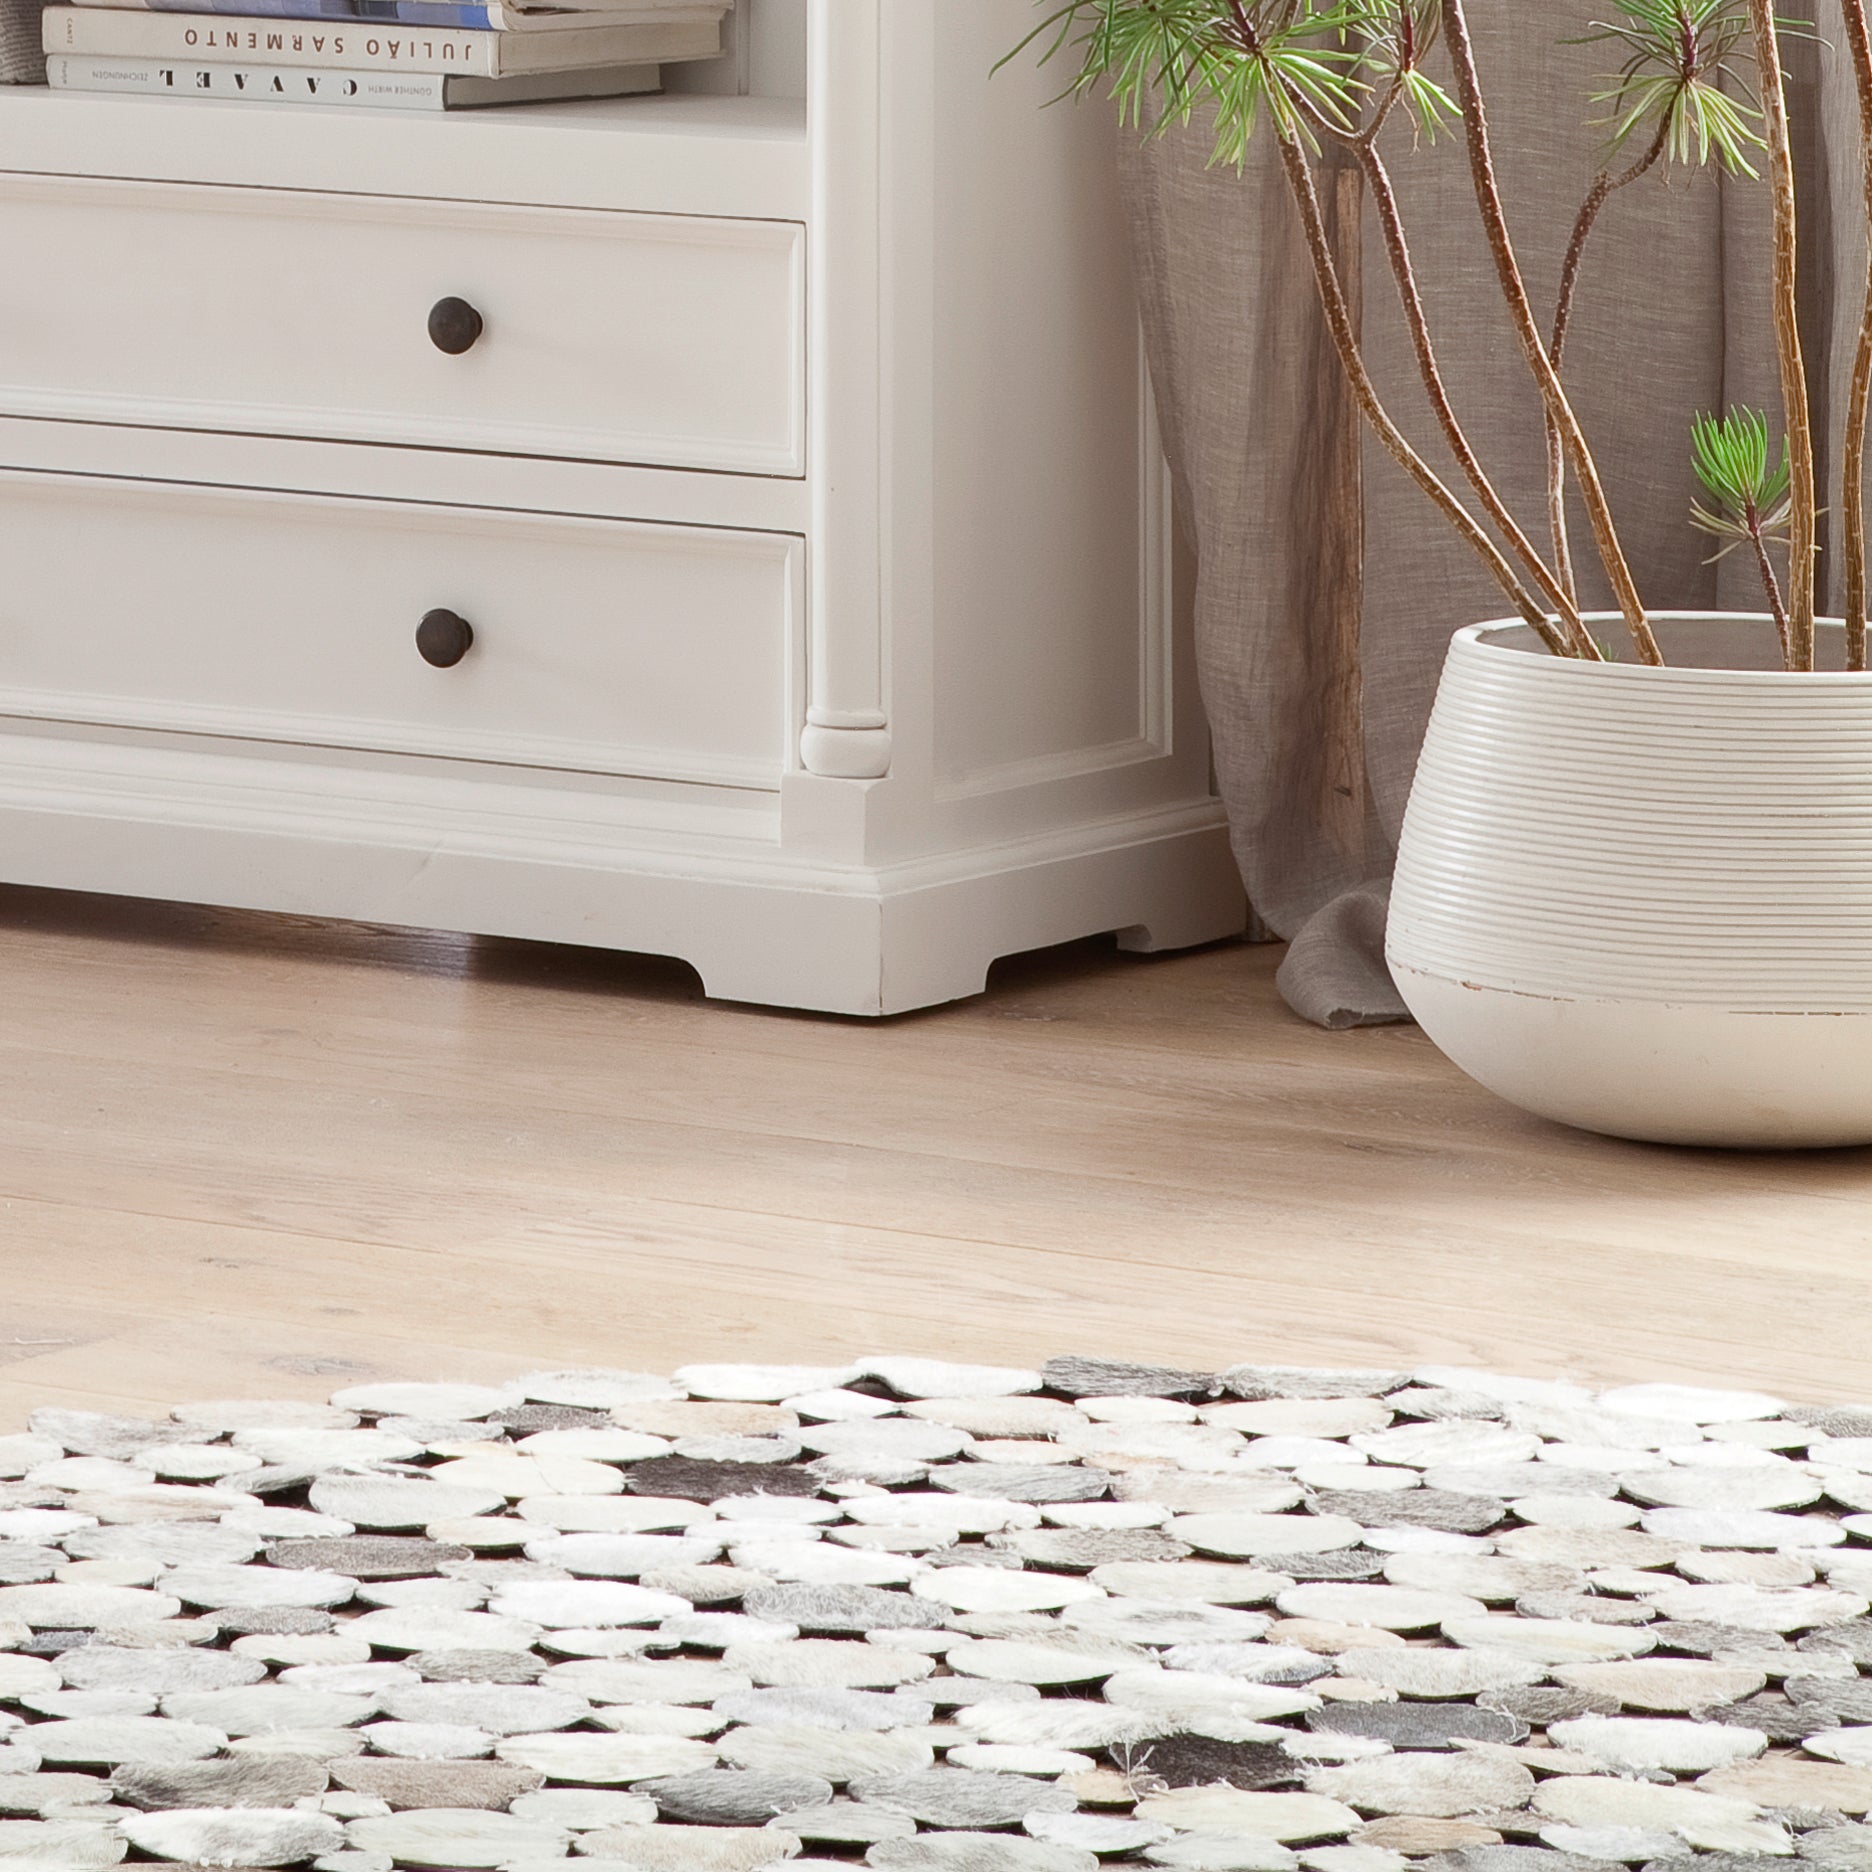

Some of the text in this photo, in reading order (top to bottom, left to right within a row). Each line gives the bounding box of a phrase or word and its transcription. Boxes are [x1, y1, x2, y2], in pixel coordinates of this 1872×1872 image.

[184, 28, 471, 60] JULIÃO SARMENTO
[92, 70, 149, 82] ZEICHNUNGEN
[368, 84, 432, 97] GÜNTHER WIRTH
